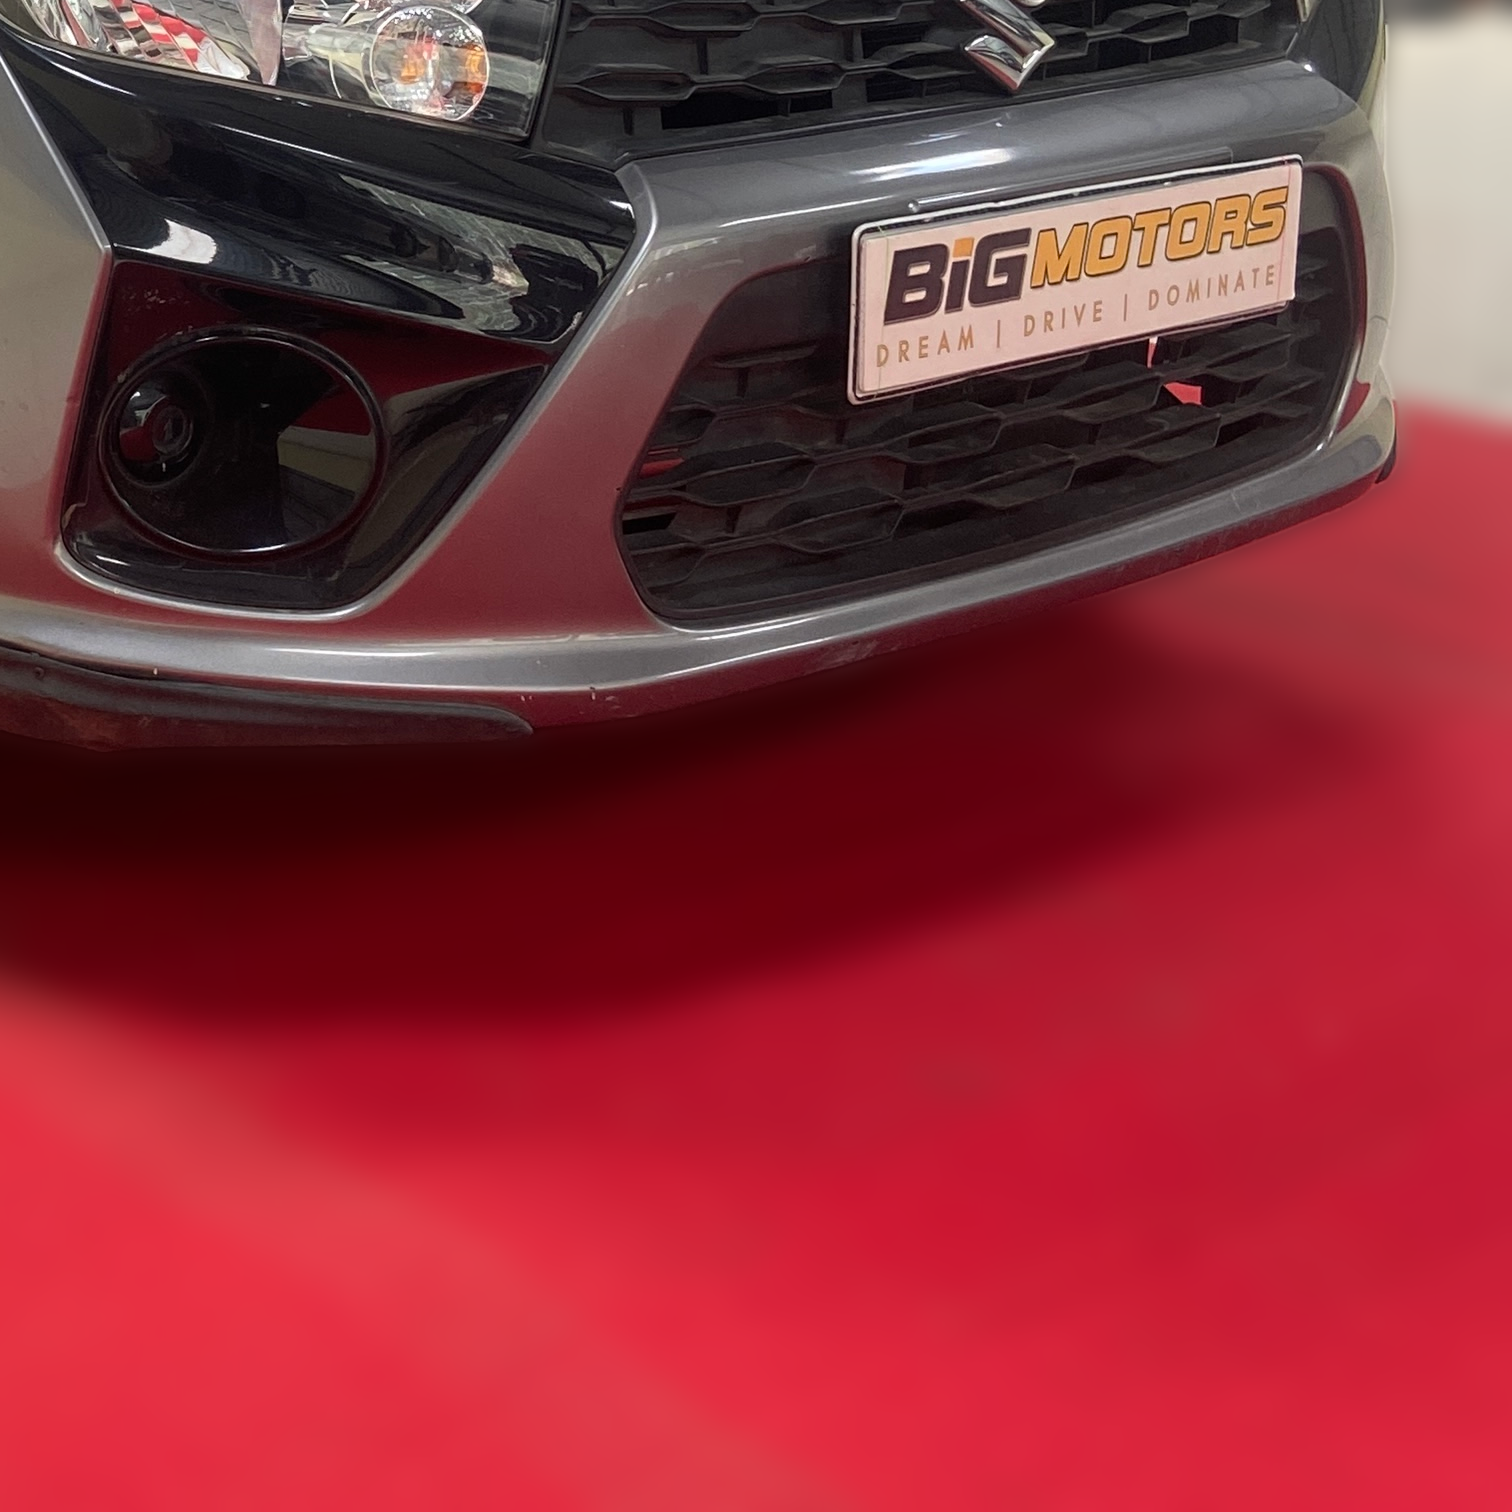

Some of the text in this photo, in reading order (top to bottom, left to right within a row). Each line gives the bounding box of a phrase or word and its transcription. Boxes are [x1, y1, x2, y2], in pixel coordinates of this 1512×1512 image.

[1031, 186, 1289, 288] MOTORS
[876, 264, 1276, 368] DREAM DRIVE DOMINATE
